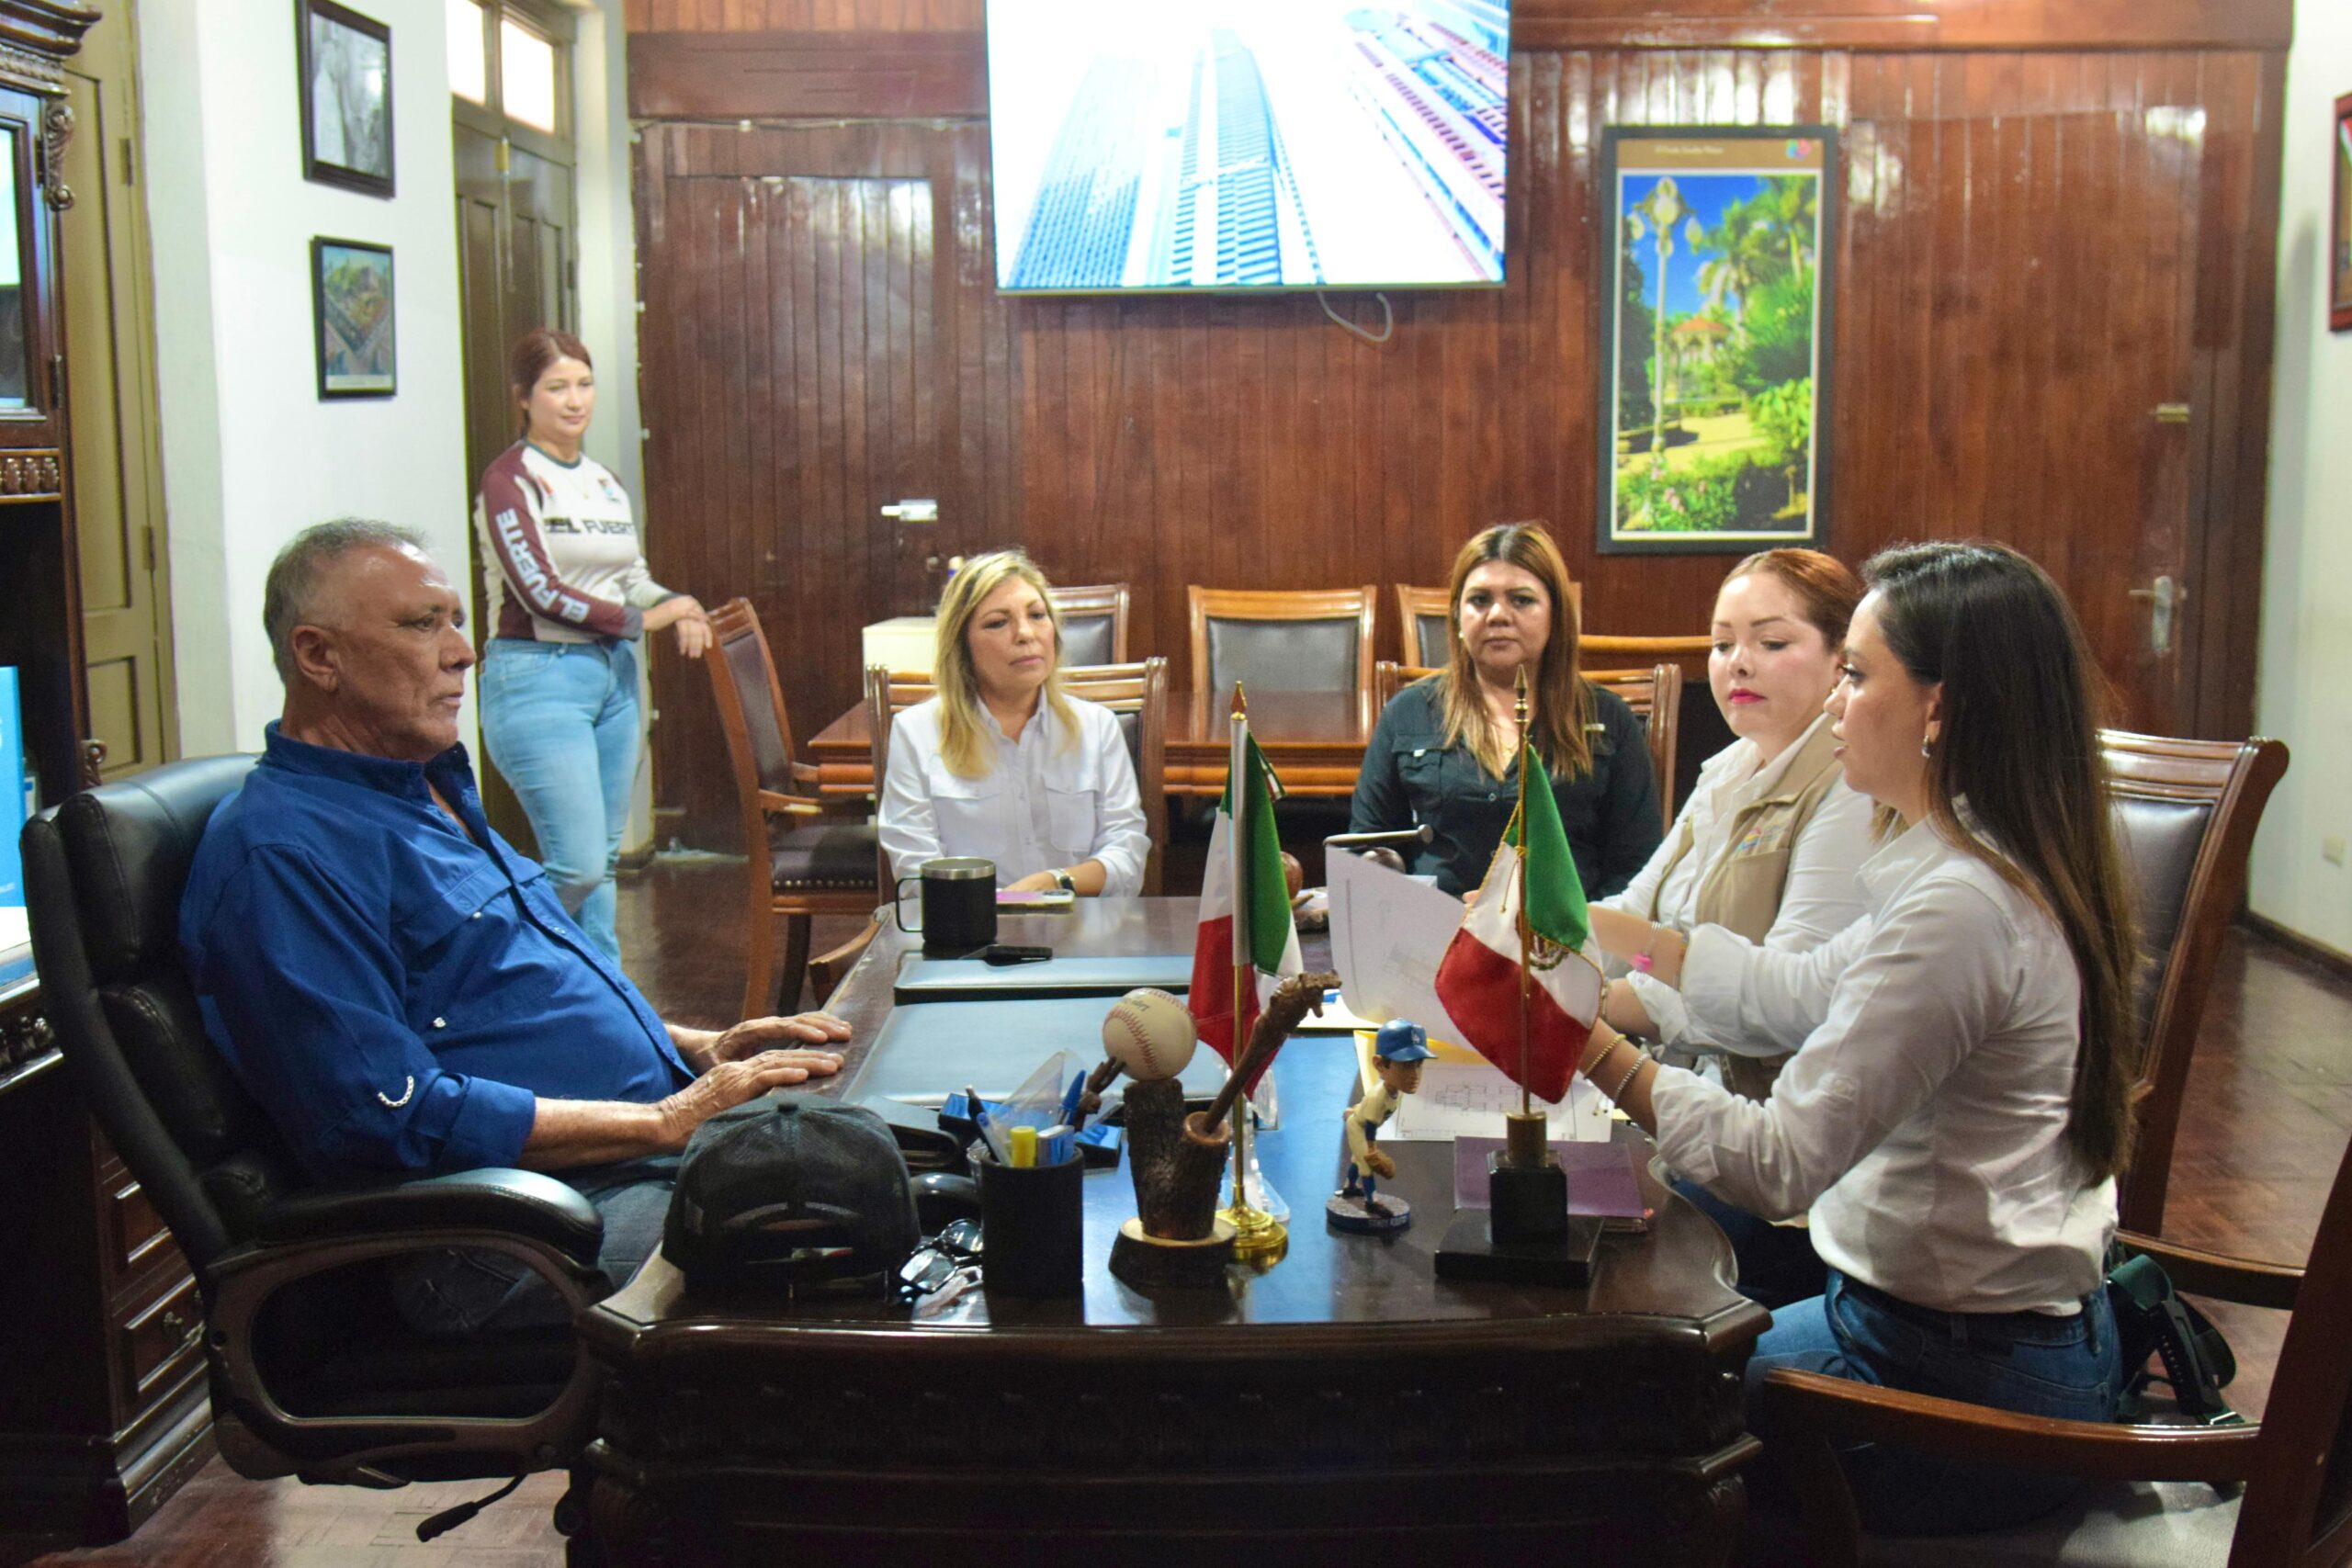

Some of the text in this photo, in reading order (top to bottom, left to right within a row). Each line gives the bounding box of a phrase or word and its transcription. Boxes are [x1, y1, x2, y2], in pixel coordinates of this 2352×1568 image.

[544, 518, 581, 534] EL
[495, 508, 590, 623] EL FUERTE
